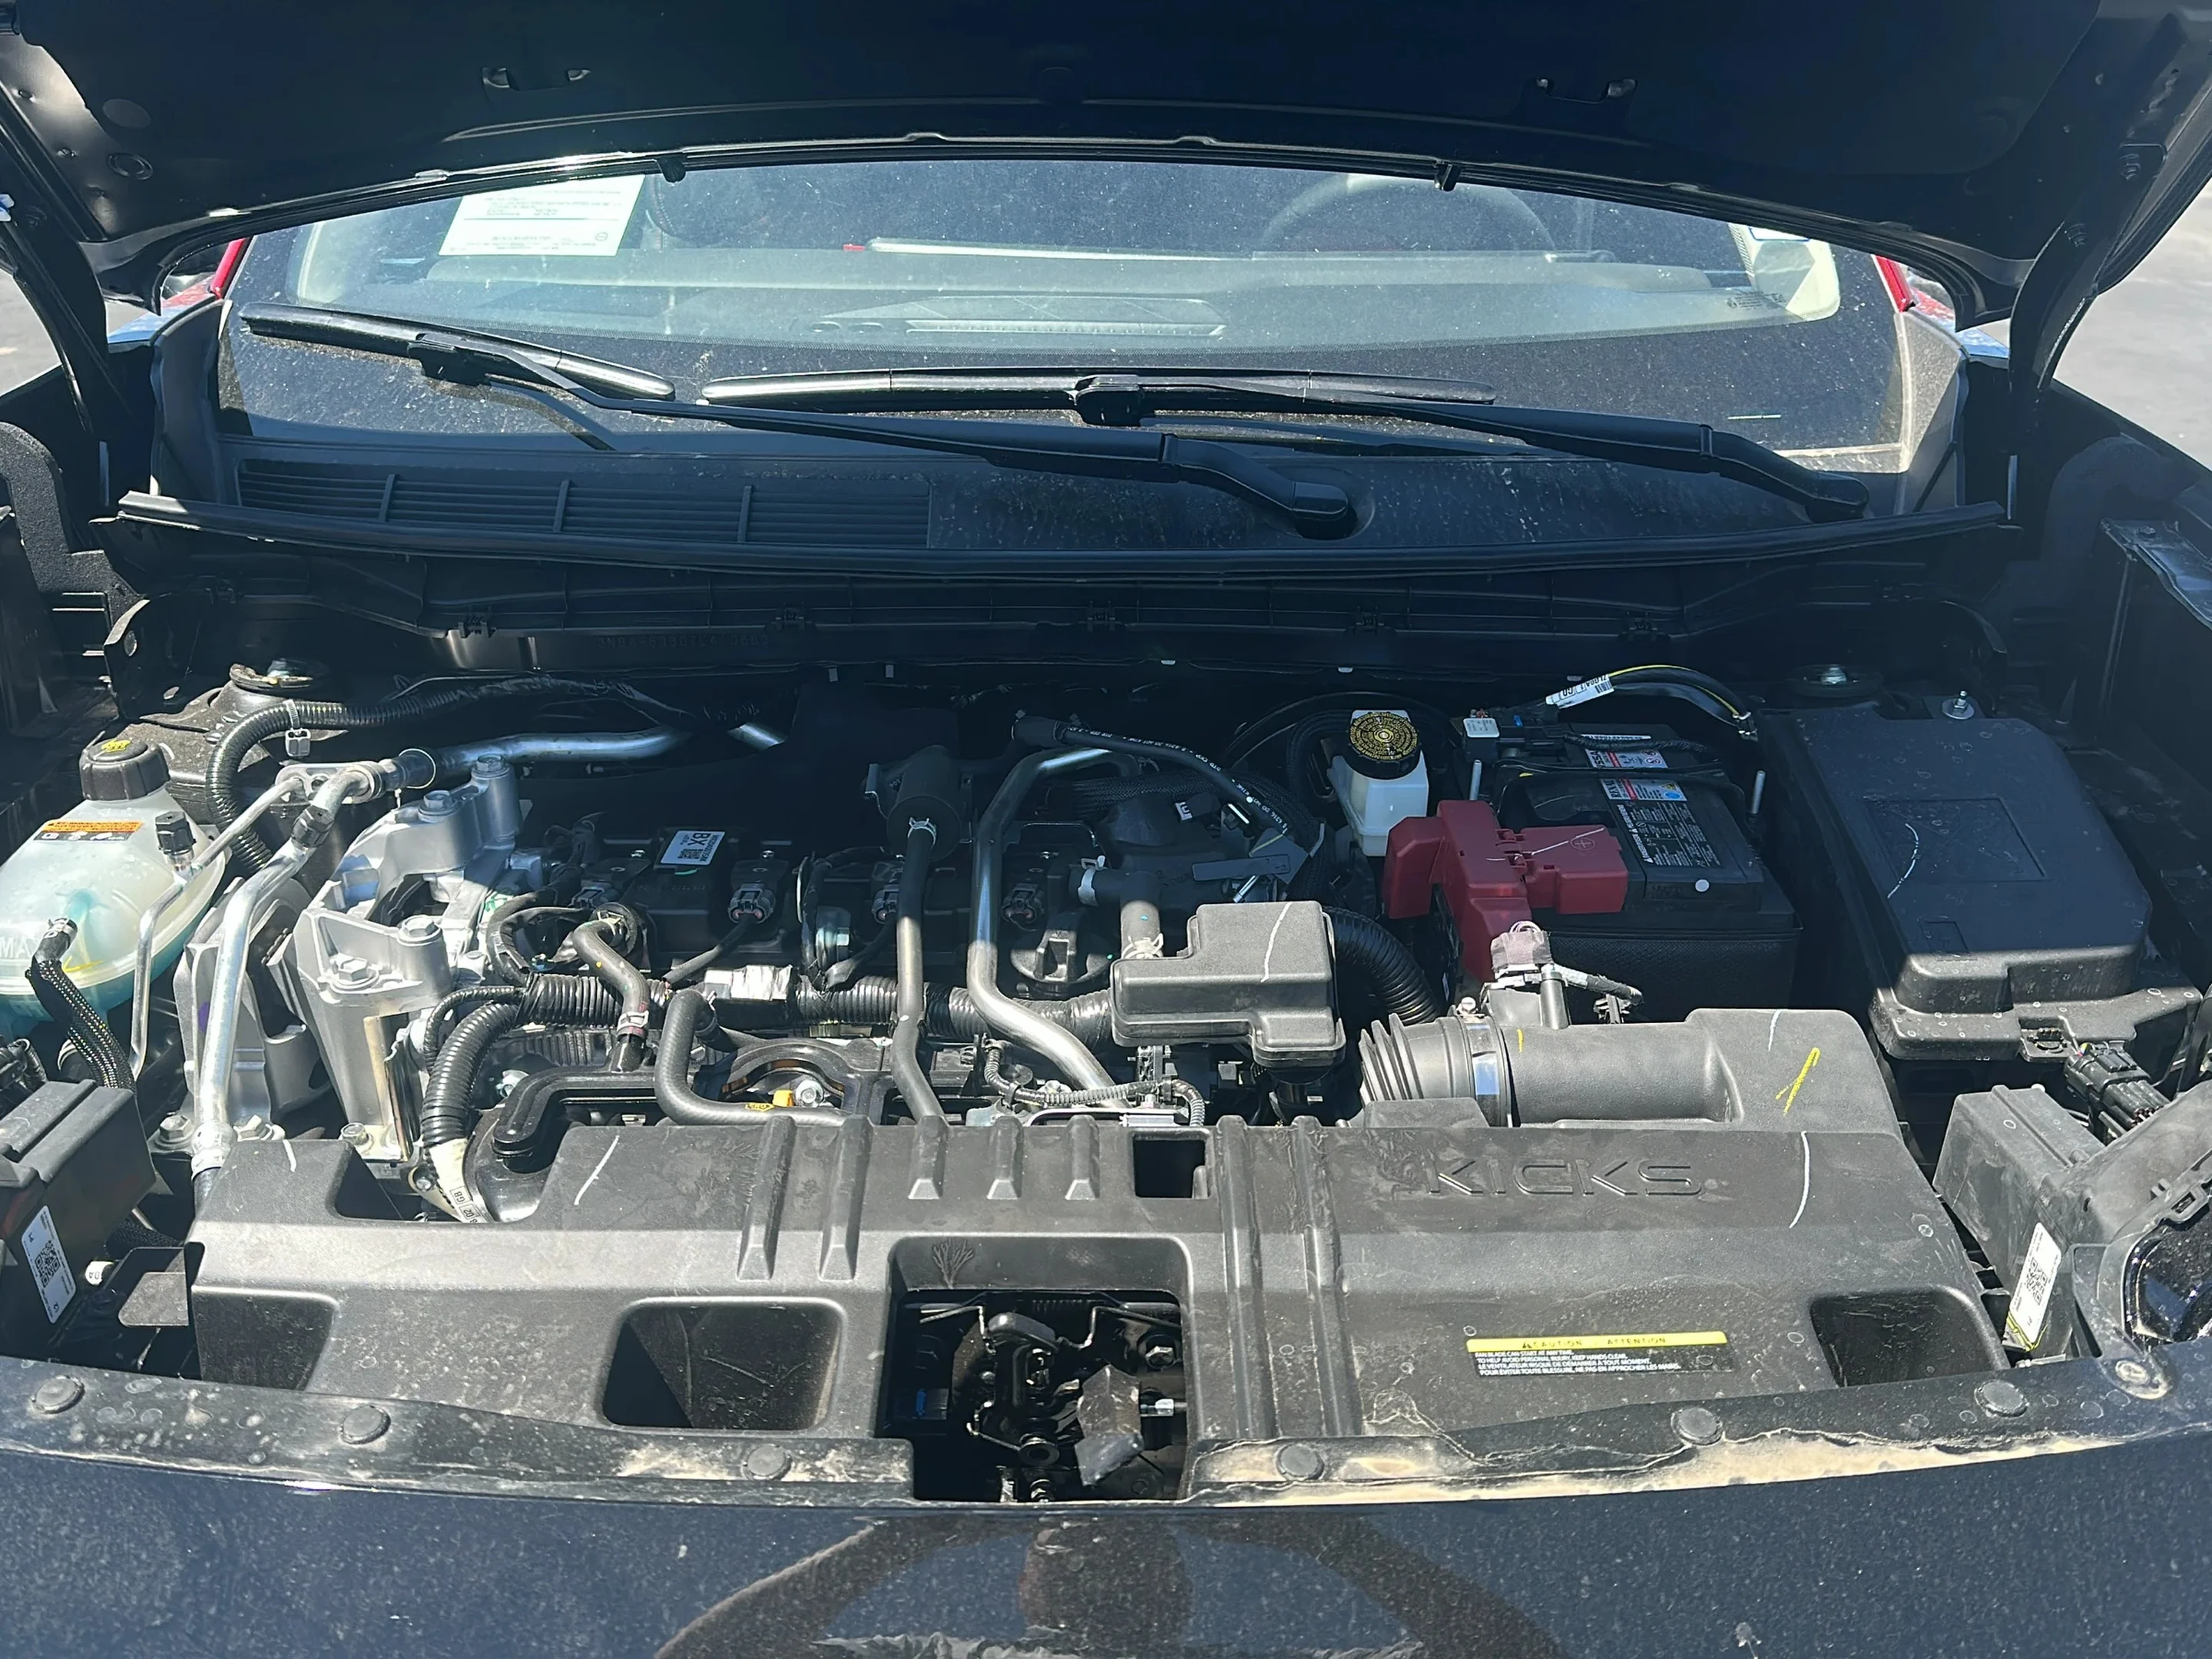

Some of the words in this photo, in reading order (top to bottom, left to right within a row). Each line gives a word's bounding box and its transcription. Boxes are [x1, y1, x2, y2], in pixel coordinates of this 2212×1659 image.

[687, 833, 712, 846] BX
[1421, 1154, 1702, 1197] KICKS
[454, 1190, 465, 1204] GB
